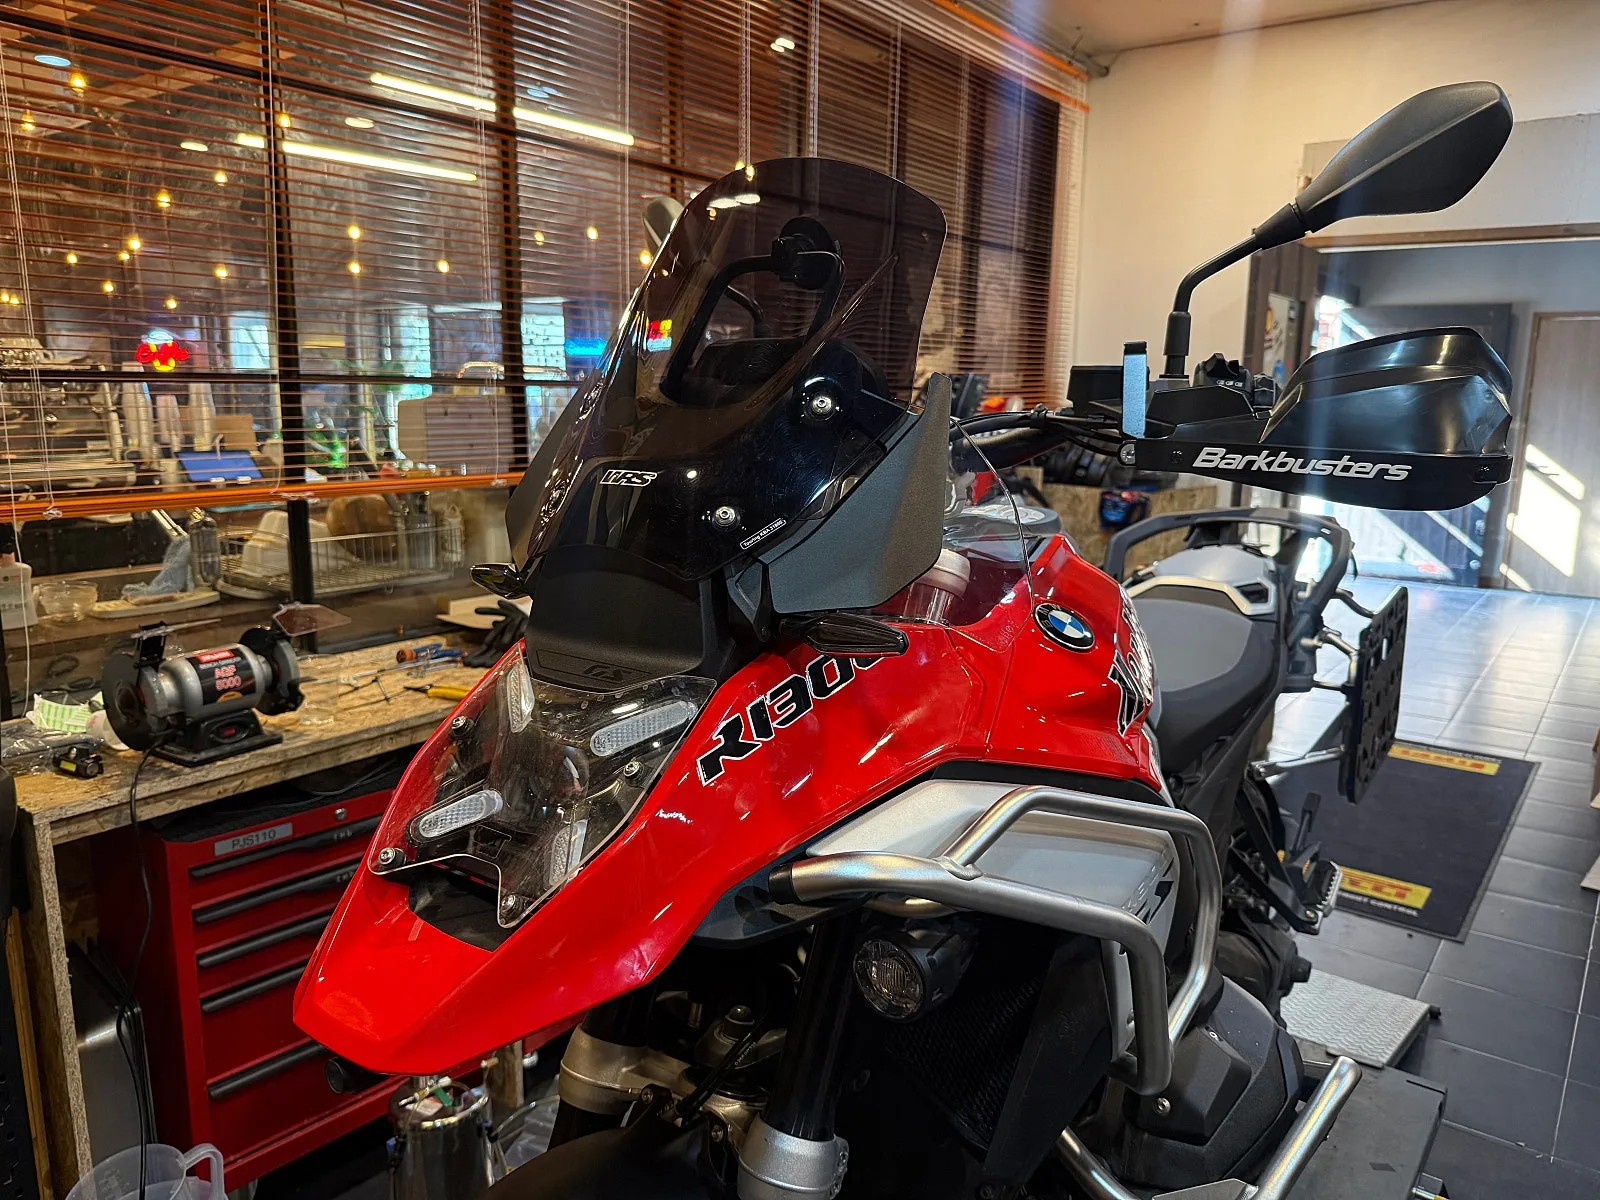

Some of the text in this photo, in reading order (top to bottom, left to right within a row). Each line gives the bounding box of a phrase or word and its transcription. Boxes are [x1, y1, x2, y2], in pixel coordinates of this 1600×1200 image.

[1192, 446, 1413, 481] Barkbusters
[696, 654, 886, 788] R130
[231, 828, 277, 849] PJS110
